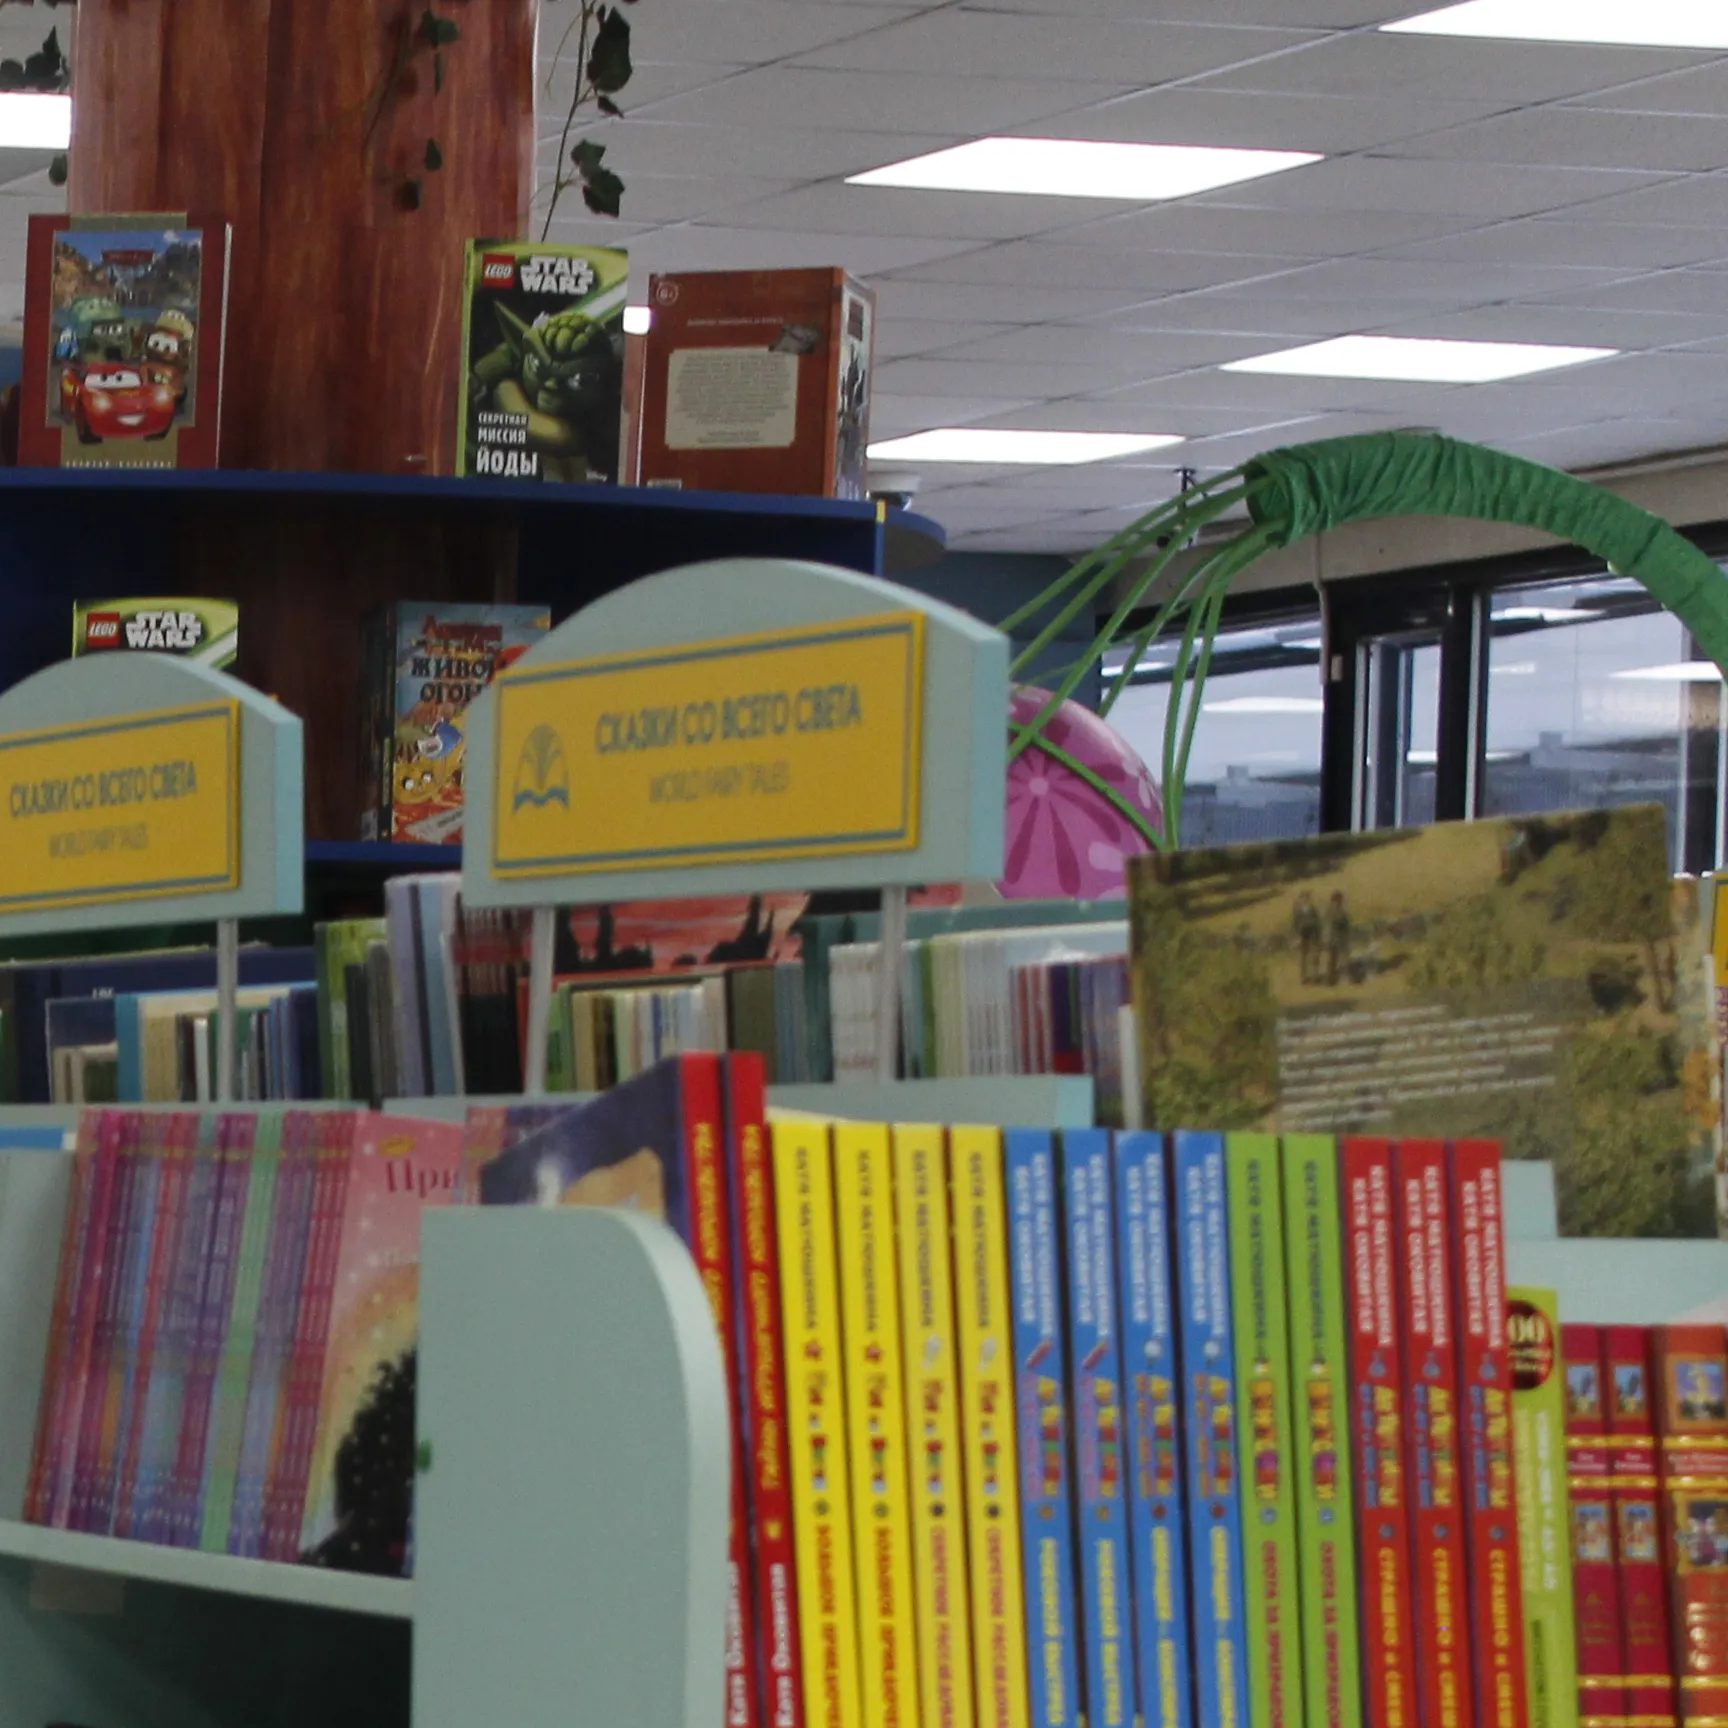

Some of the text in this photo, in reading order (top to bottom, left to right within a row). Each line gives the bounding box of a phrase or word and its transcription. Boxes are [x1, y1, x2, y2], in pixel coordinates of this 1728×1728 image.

[483, 263, 513, 279] LEGO
[528, 255, 588, 276] STAR
[520, 270, 594, 295] WARS
[478, 411, 528, 425] СЕКРЕТНАЯ
[477, 427, 527, 444] МИССИЯ
[475, 446, 539, 477] ЙОДЫ
[87, 621, 118, 638] LEGO
[132, 610, 198, 629] STAR
[125, 624, 202, 649] WARS
[596, 681, 863, 755] СКАЗКИ СО ВСЕГО СВЕТА
